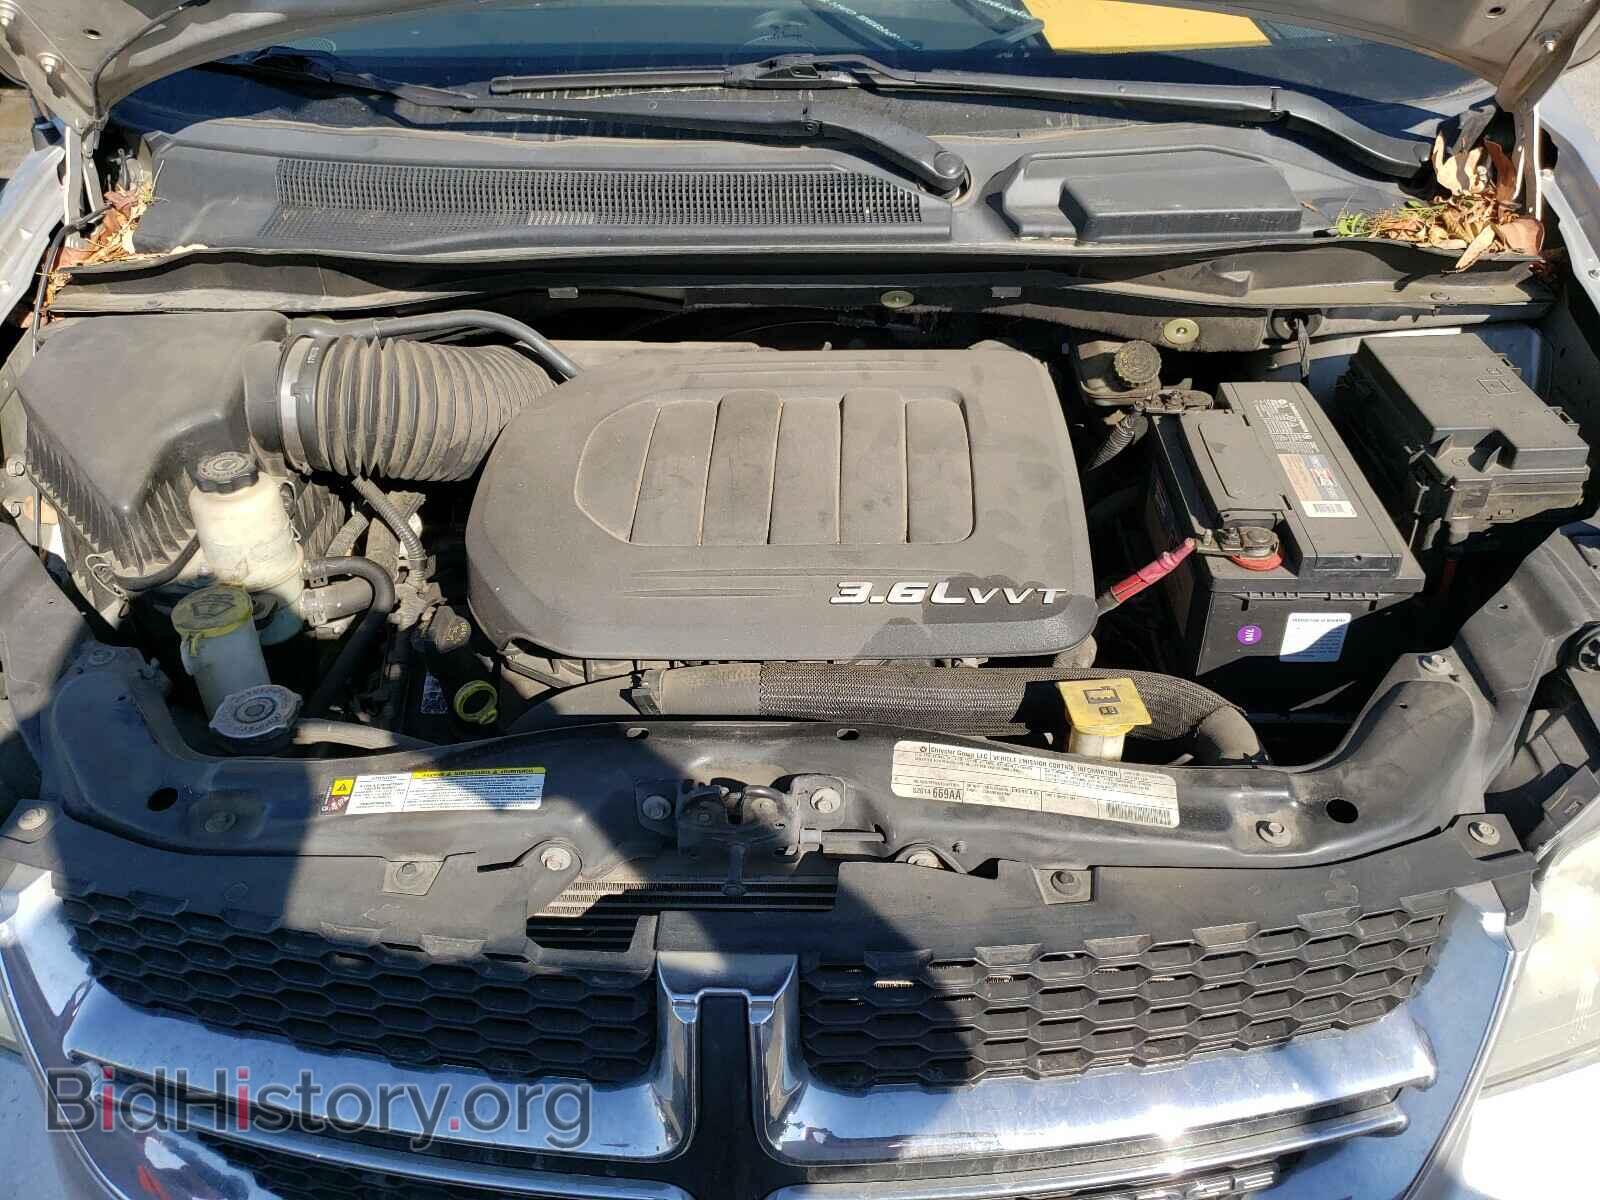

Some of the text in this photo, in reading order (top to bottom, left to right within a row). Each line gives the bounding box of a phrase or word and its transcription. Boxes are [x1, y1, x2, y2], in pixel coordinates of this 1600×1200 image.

[829, 581, 1067, 604] 3.6L VVT
[957, 749, 975, 759] Group
[976, 752, 988, 760] LLC
[993, 753, 1016, 764] VEHICLE
[1018, 757, 1047, 768] EMISSION
[1048, 761, 1074, 772] CONTROL
[1076, 766, 1119, 778] INFORMATION
